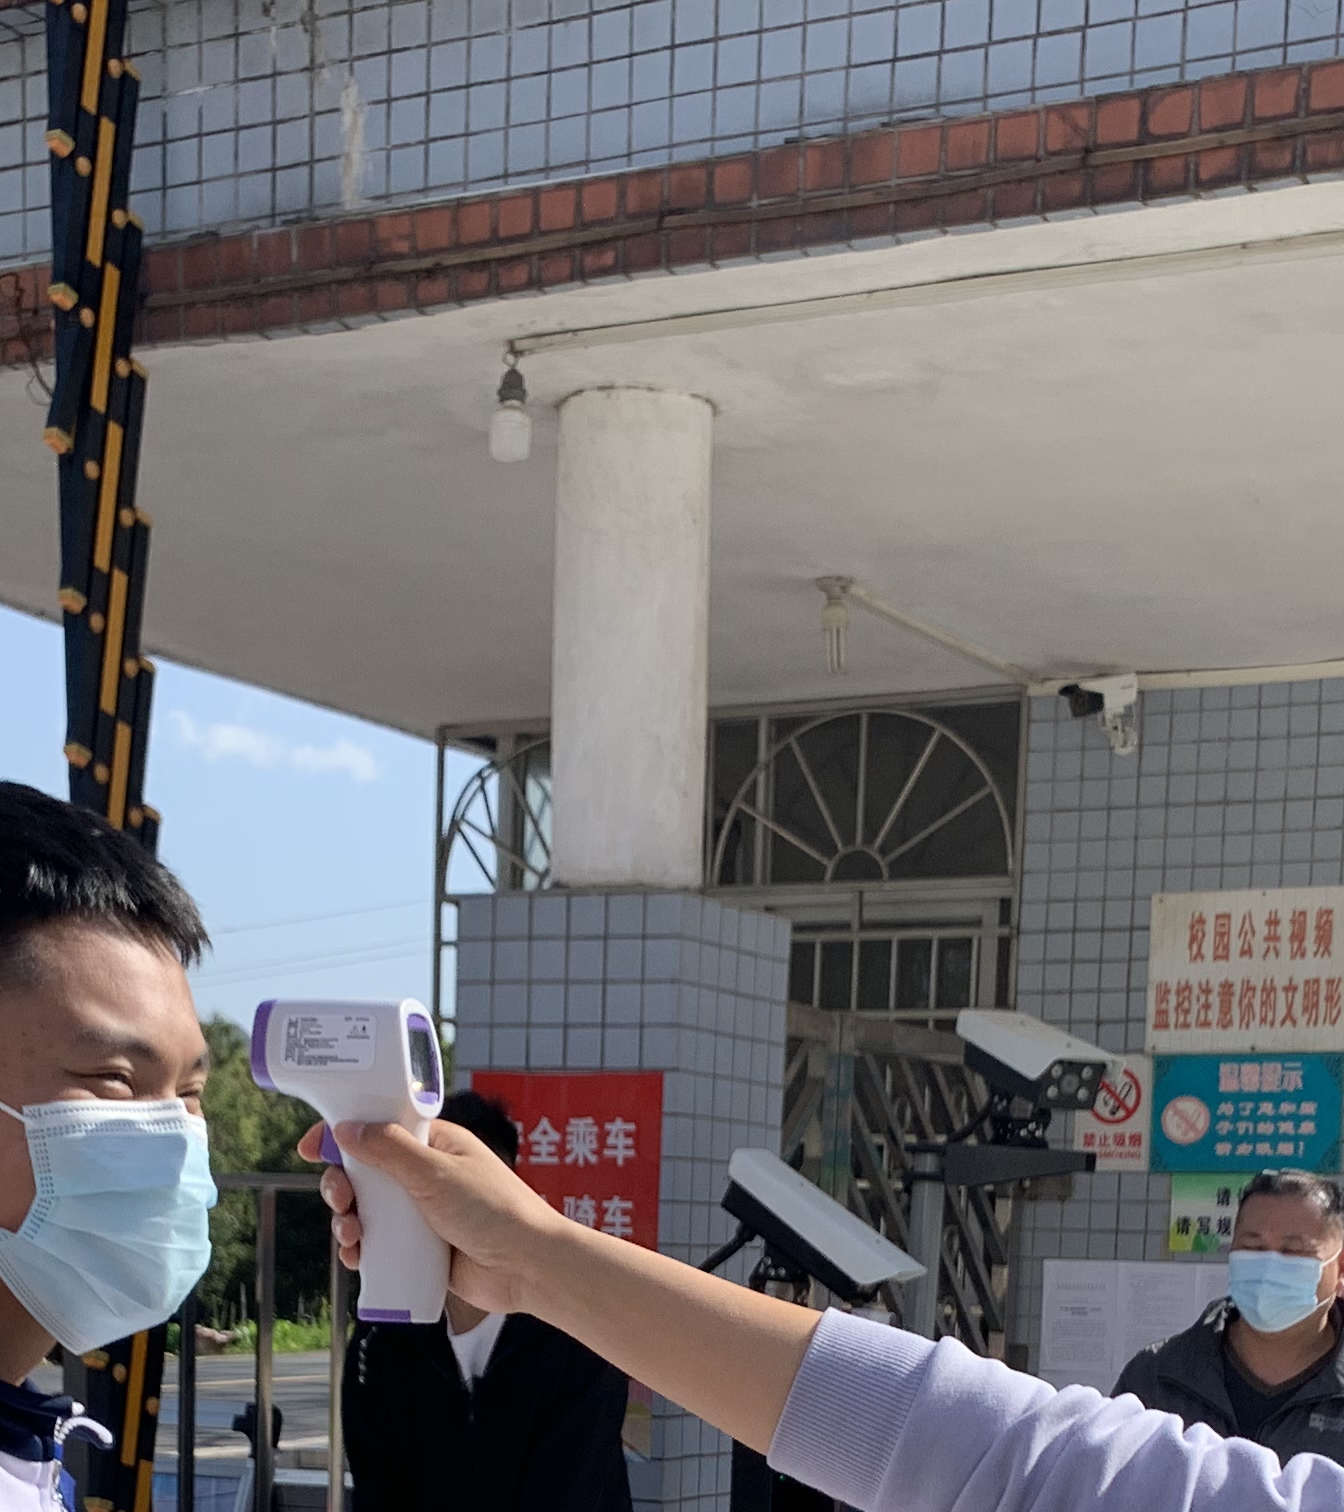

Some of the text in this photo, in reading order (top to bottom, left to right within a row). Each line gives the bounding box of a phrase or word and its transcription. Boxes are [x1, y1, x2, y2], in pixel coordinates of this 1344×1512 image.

[1188, 907, 1334, 963] 校园公共视频
[1083, 1132, 1142, 1148] 禁止吸烟
[539, 1194, 633, 1238] 骑车
